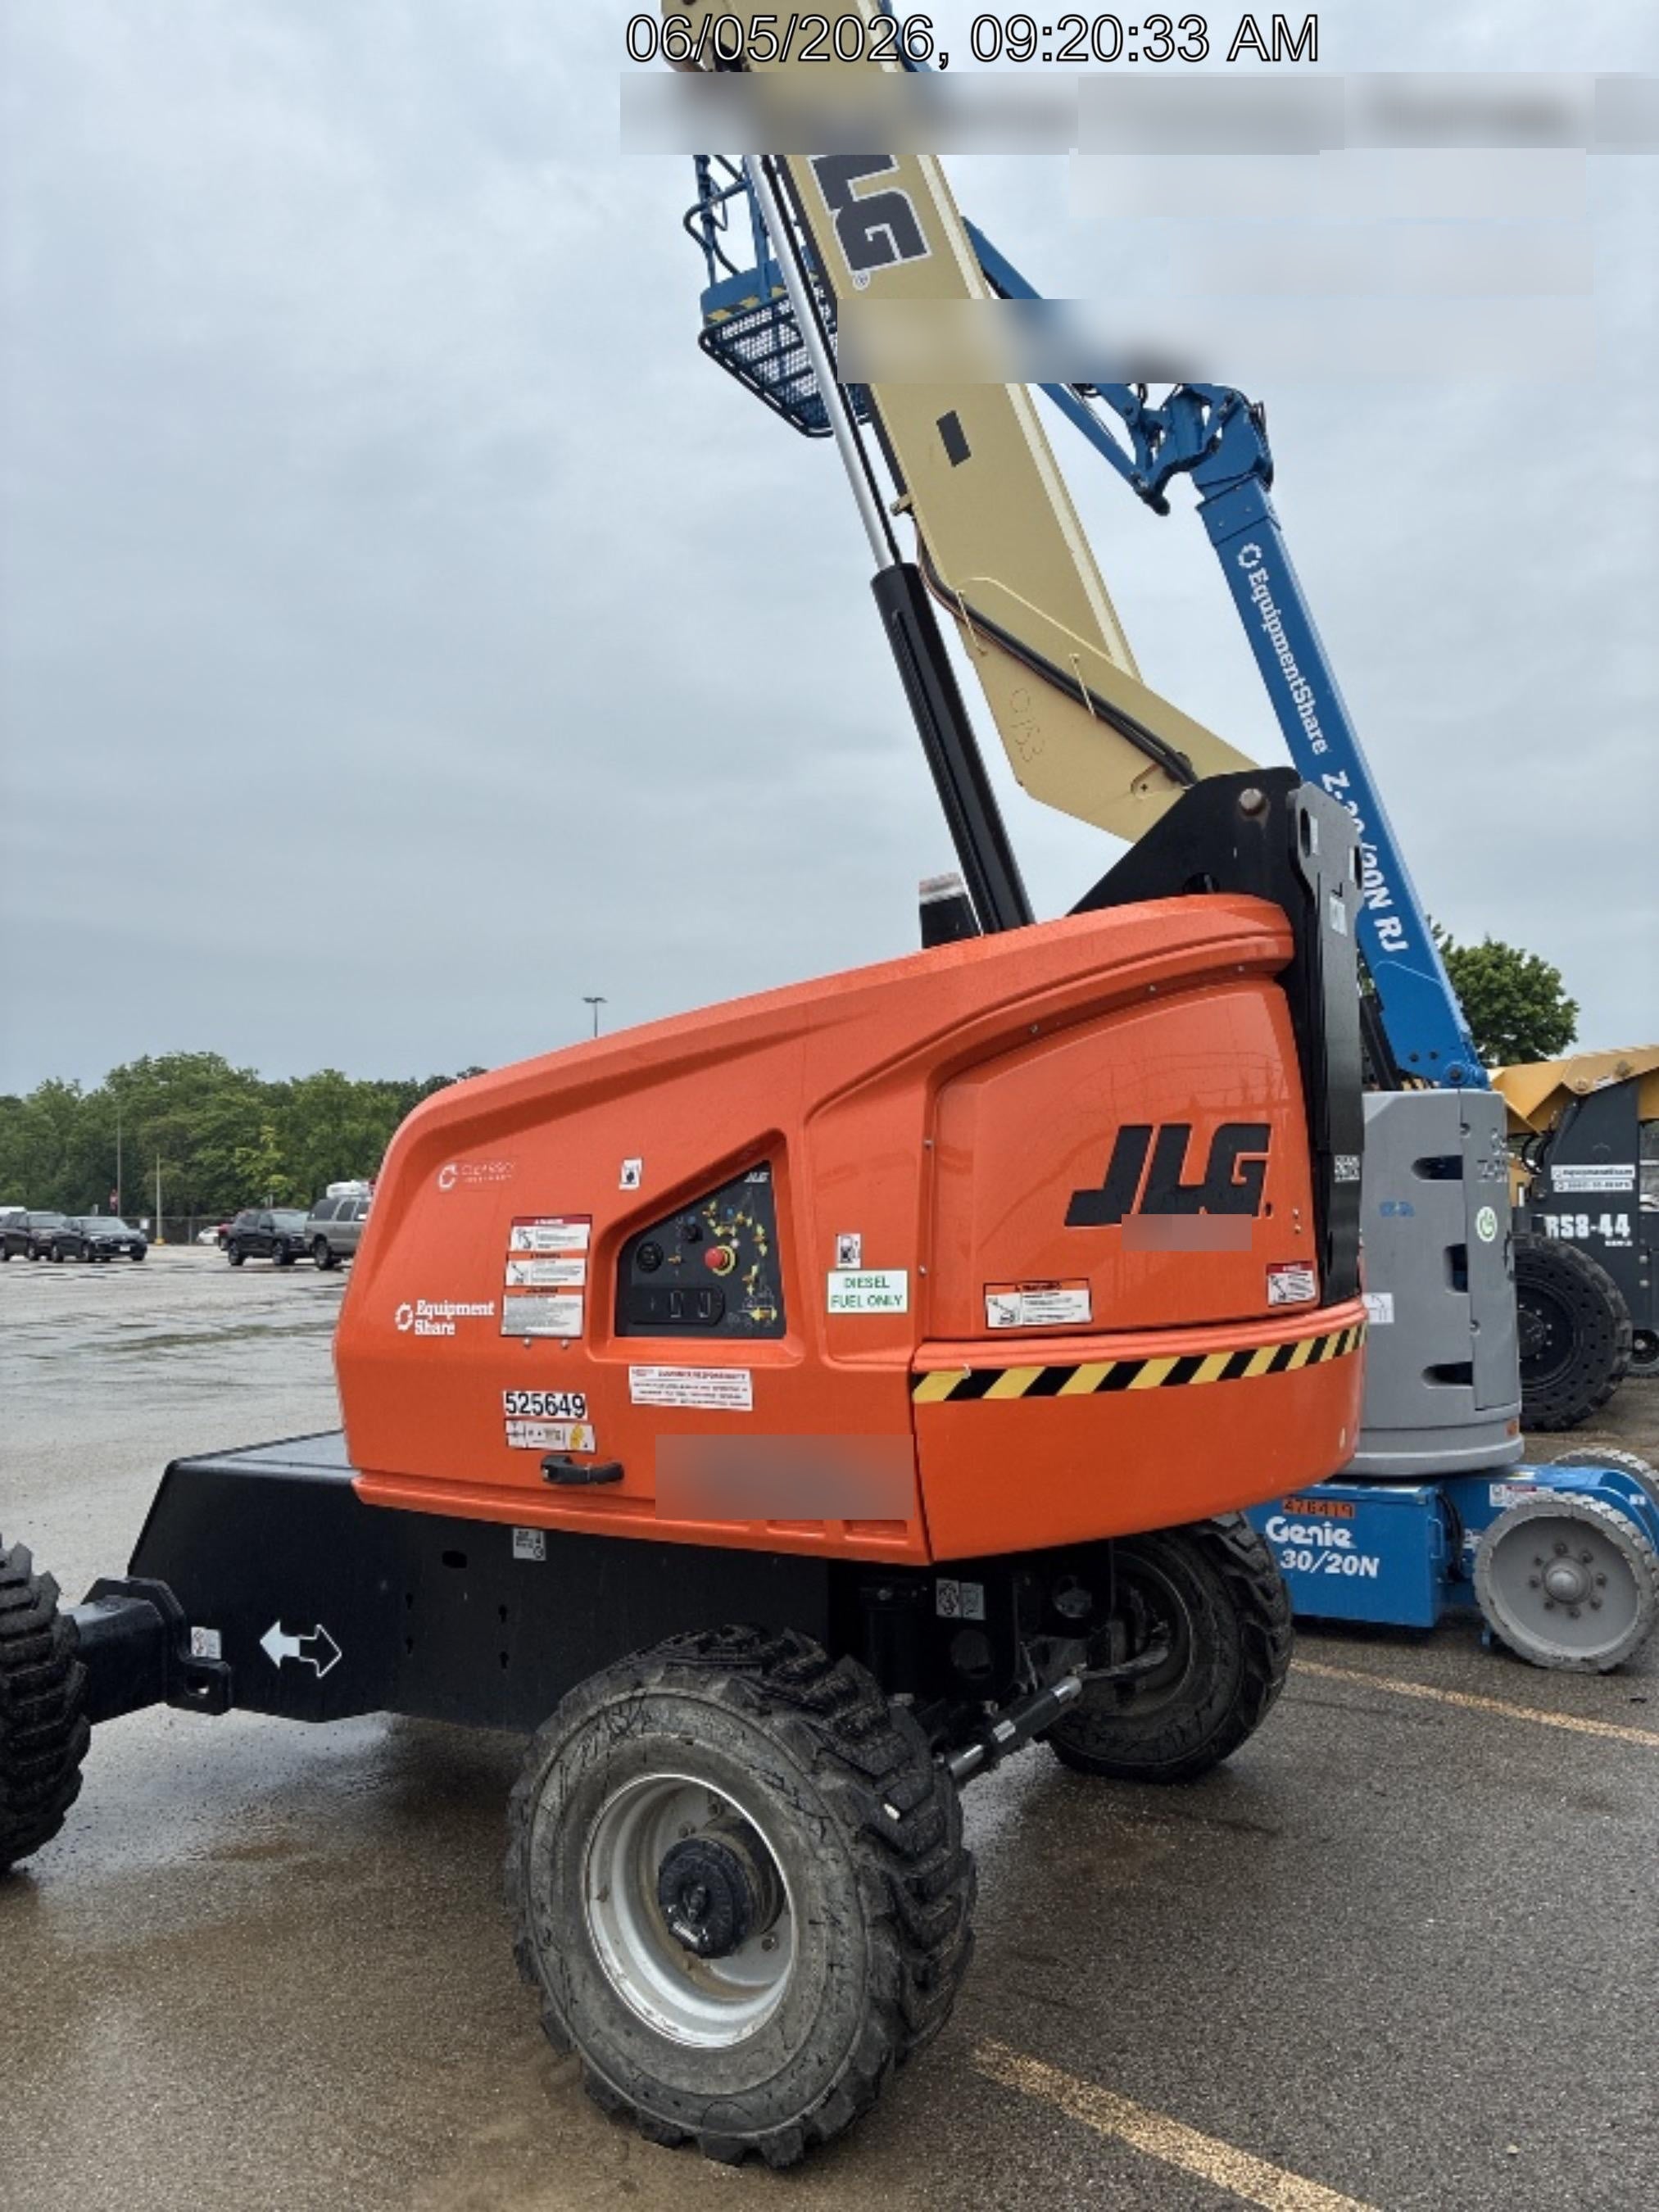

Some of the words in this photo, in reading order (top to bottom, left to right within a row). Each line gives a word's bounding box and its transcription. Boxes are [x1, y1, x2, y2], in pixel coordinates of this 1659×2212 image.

[1248, 567, 1327, 755] EquipmentShare
[1373, 916, 1409, 953] RJ
[1064, 1123, 1271, 1226] JLG
[844, 1276, 891, 1289] DIESEL
[415, 1299, 495, 1321] Equipment
[831, 1294, 863, 1308] FUEL
[867, 1294, 903, 1307] ONLY
[415, 1320, 456, 1335] Share
[505, 1392, 586, 1418] 525649
[1265, 1516, 1357, 1549] Genie
[1280, 1548, 1380, 1579] 30/20N
